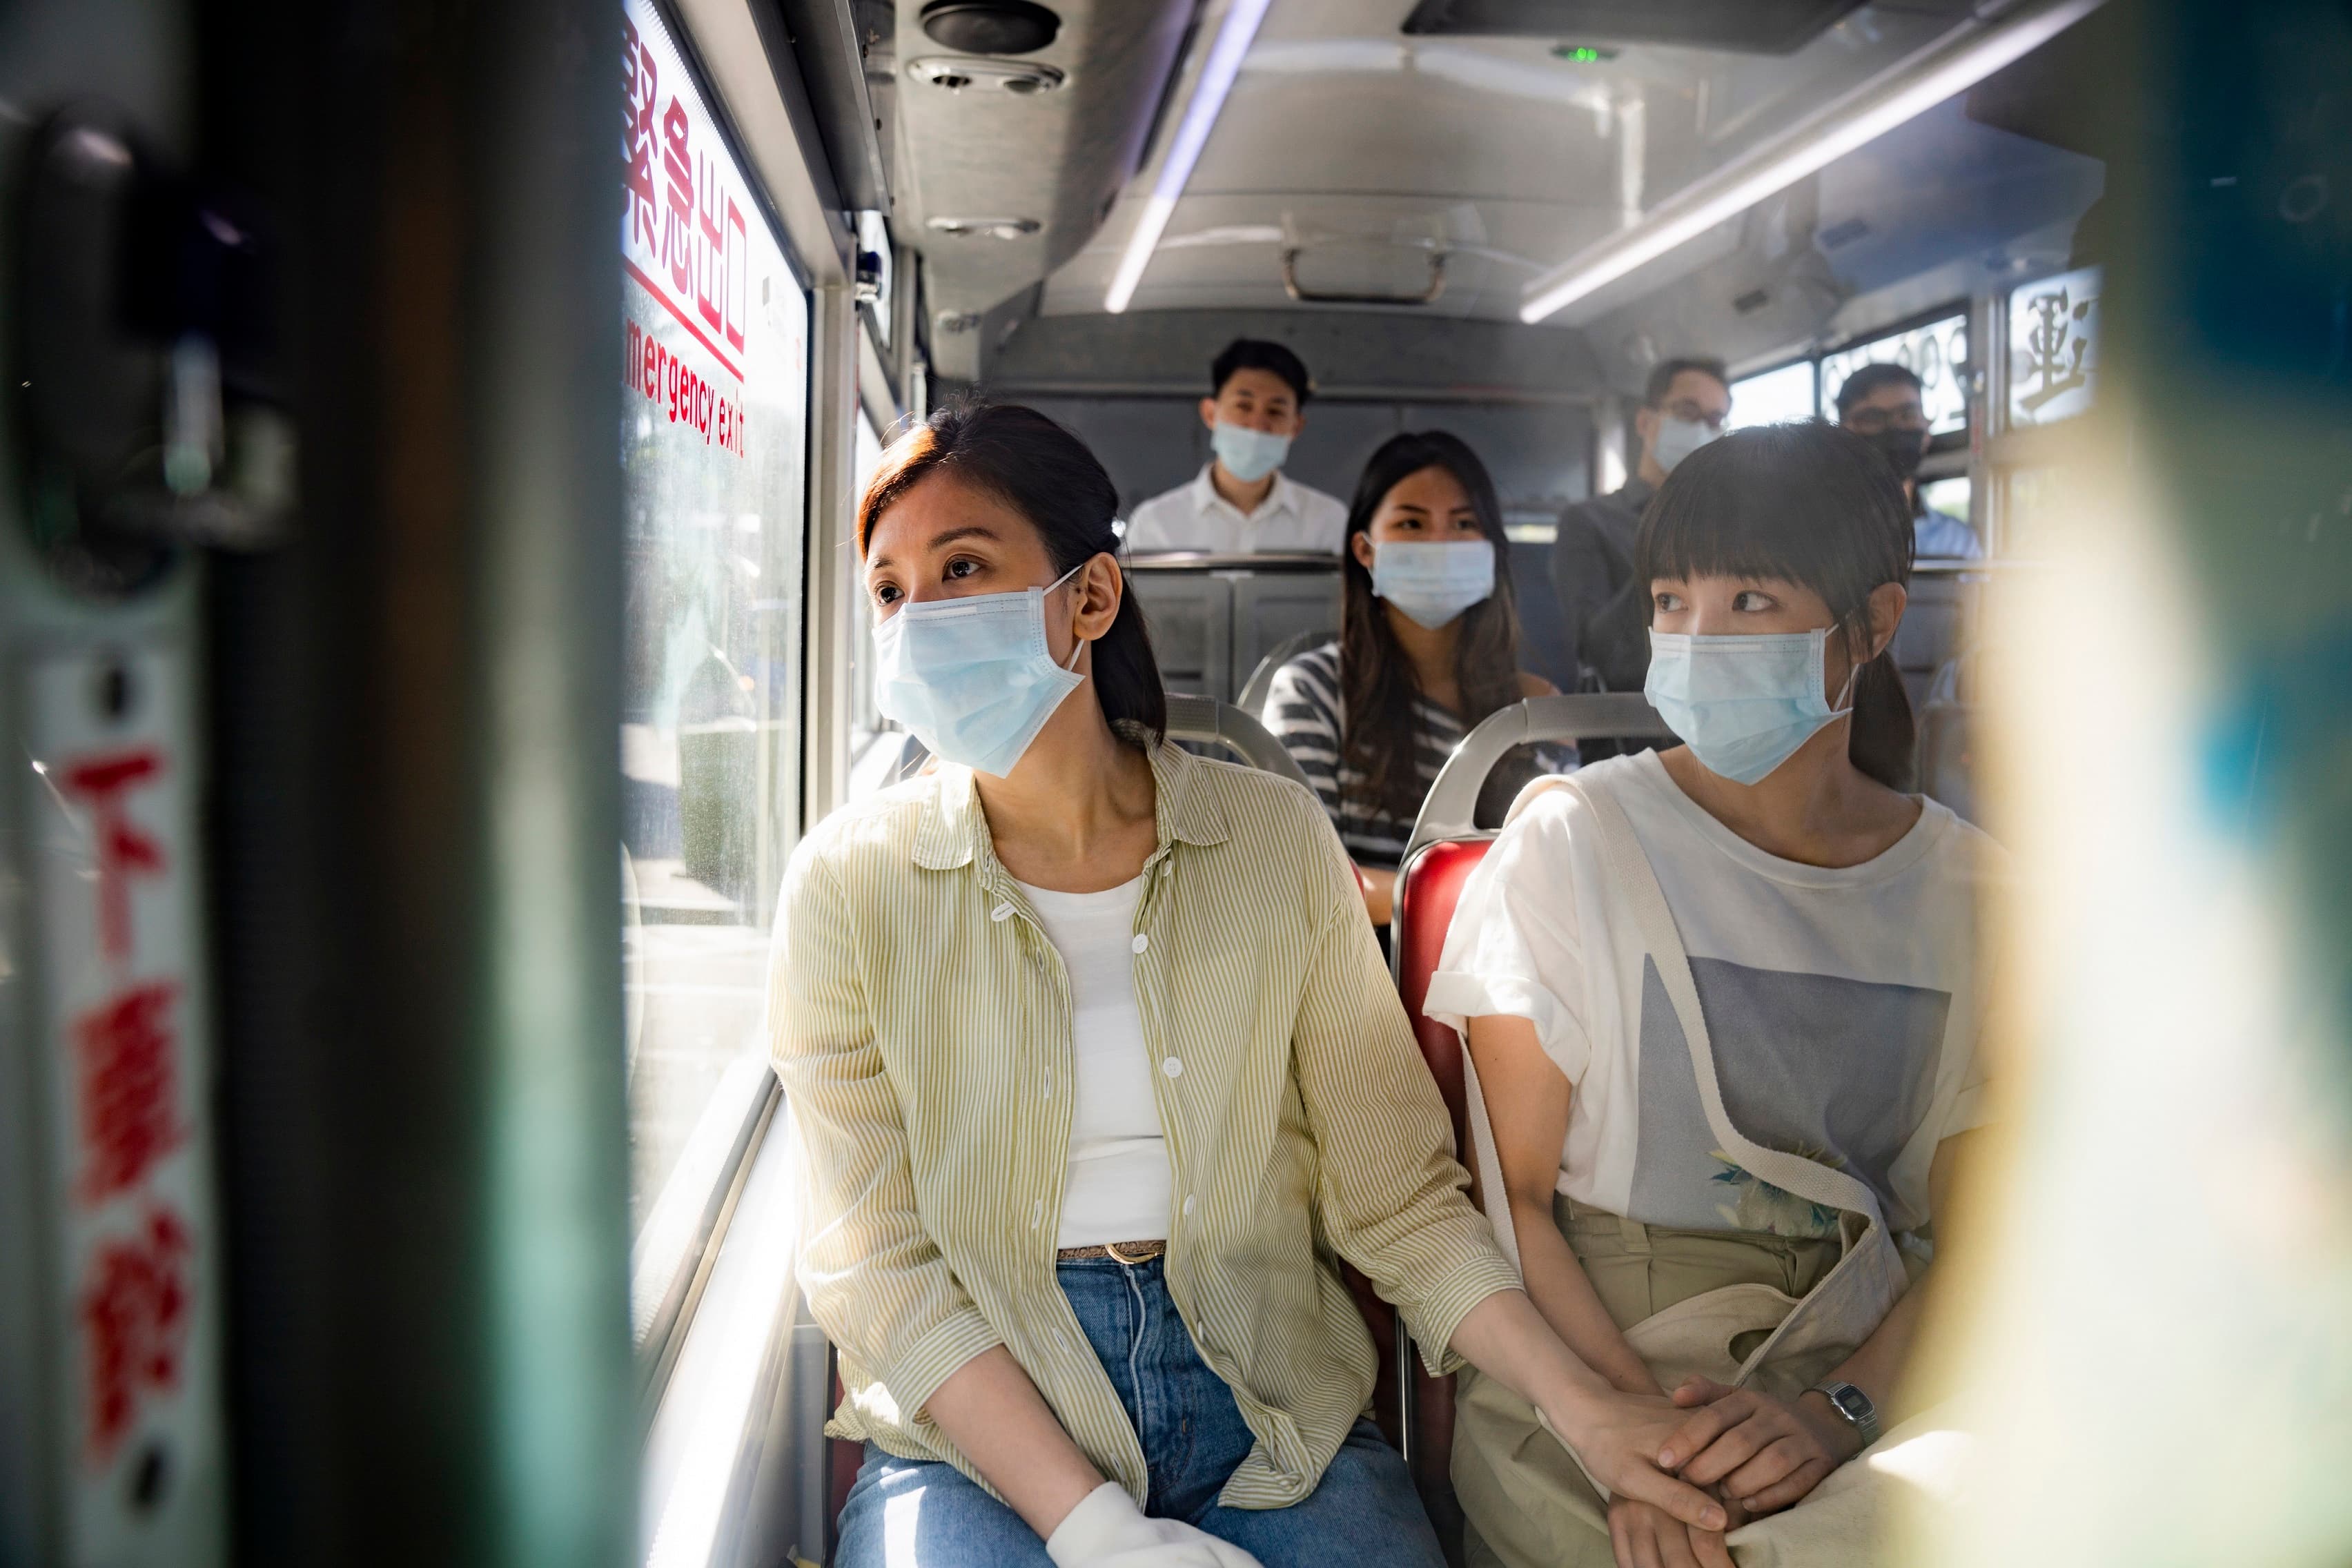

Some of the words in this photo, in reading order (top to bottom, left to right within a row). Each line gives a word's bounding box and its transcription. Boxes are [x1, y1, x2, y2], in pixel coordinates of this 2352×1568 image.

[621, 14, 745, 355] 緊急出口
[625, 317, 714, 445] mergency
[719, 387, 745, 459] exit
